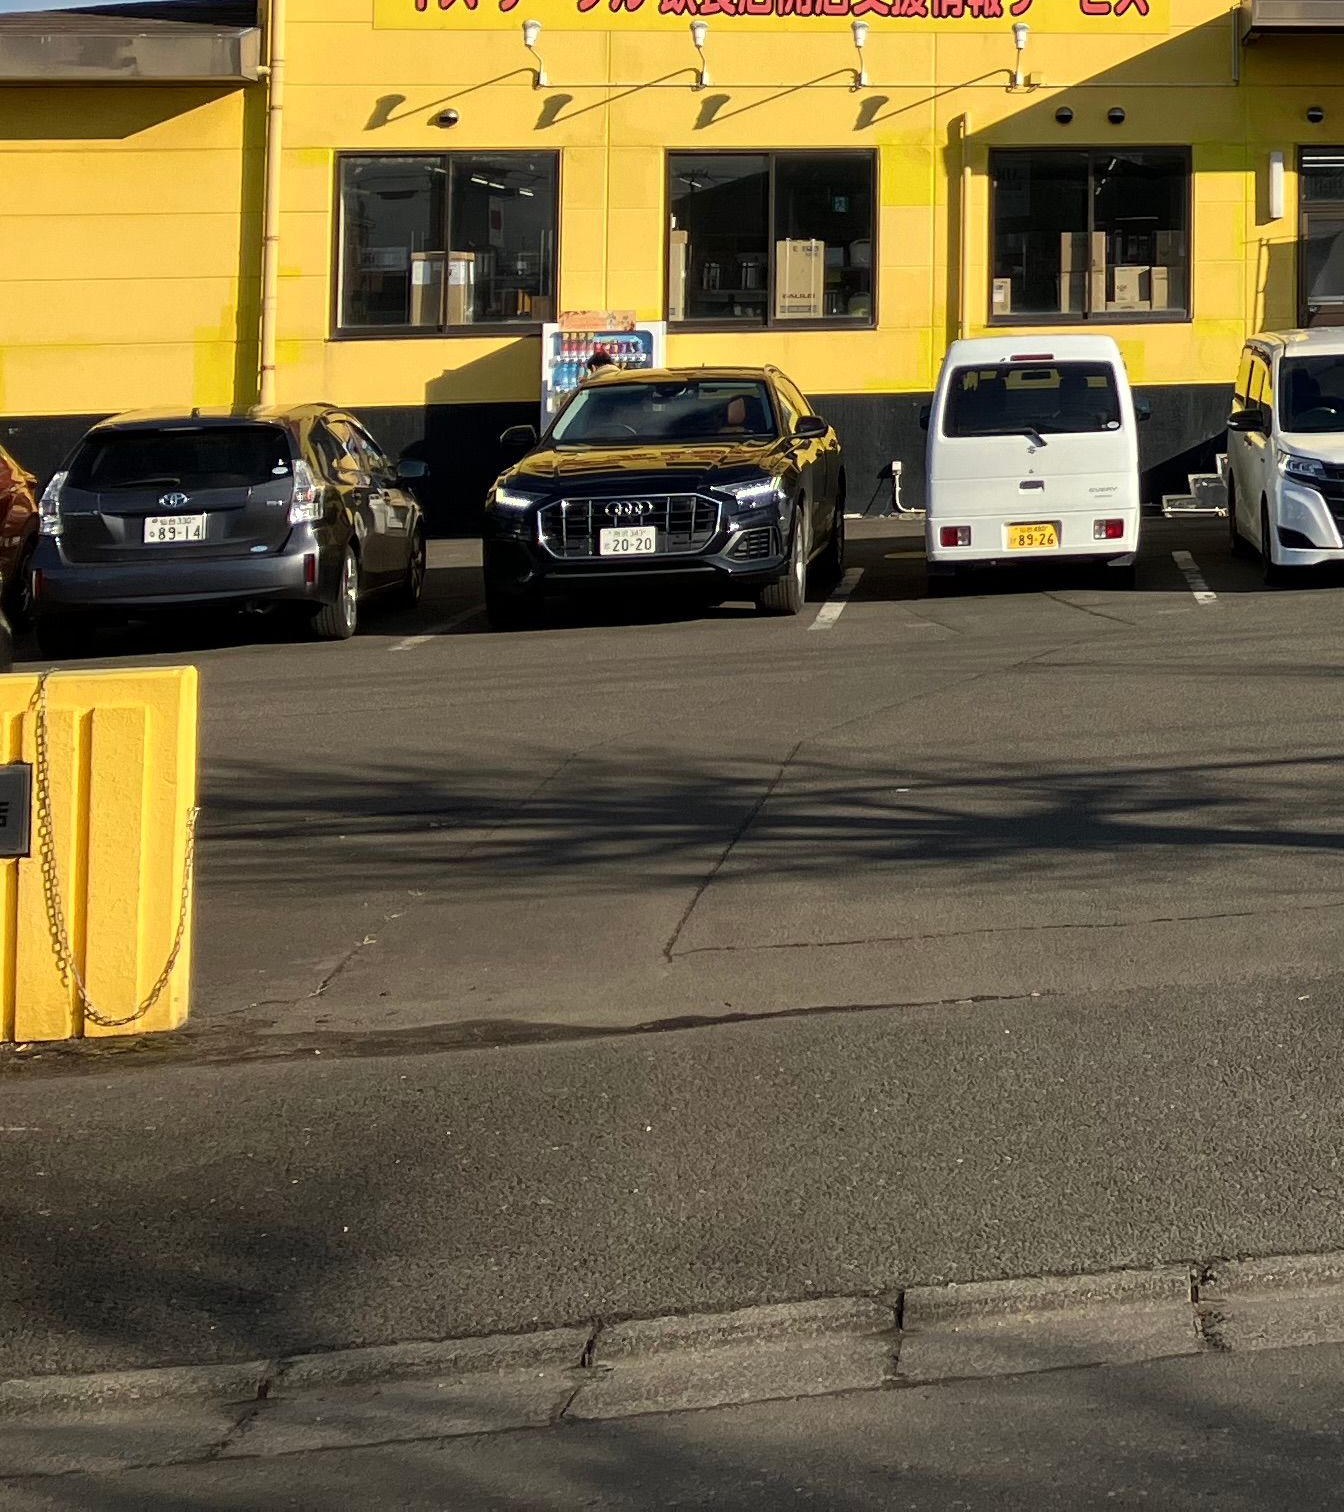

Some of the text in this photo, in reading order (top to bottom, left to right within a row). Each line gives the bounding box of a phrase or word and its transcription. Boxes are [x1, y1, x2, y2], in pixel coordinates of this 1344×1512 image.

[158, 525, 201, 541] 89-14
[1018, 533, 1055, 546] 89-26
[612, 538, 652, 552] 20-20
